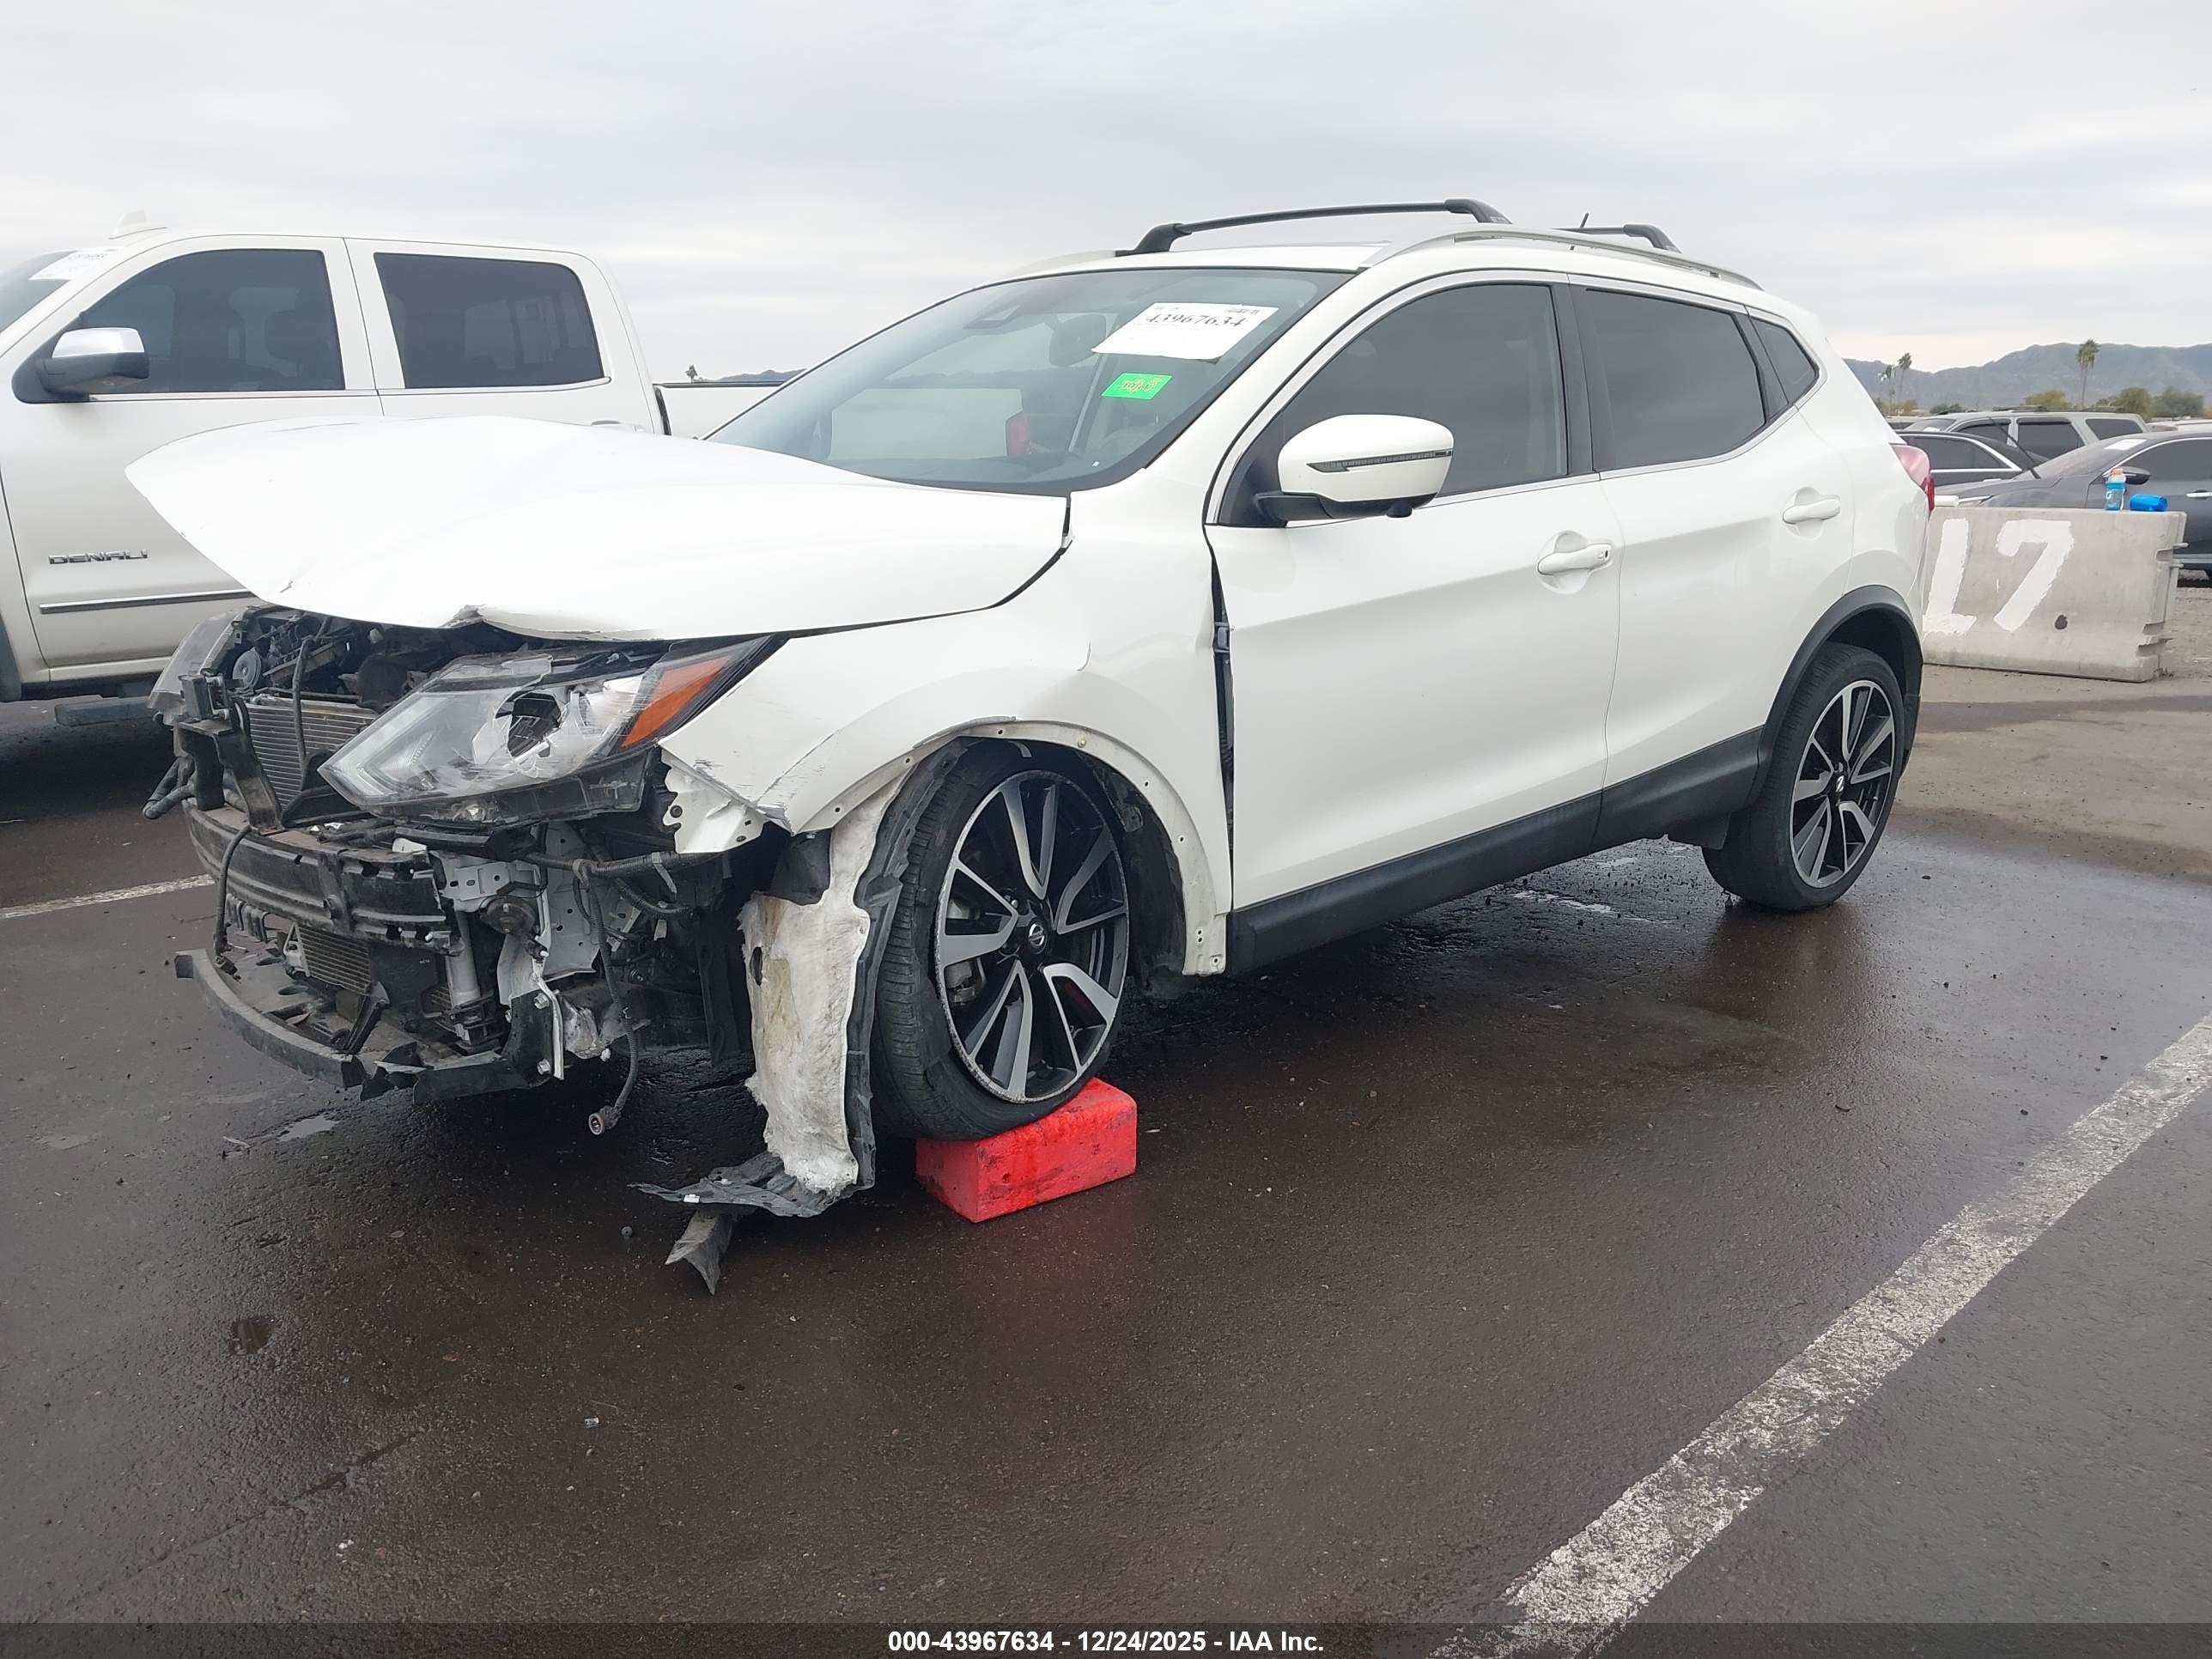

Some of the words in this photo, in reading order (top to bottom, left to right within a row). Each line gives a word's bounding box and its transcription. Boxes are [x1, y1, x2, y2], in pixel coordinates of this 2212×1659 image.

[1146, 313, 1246, 326] 43967634
[48, 550, 148, 564] DENALI
[1923, 519, 2074, 635] 17
